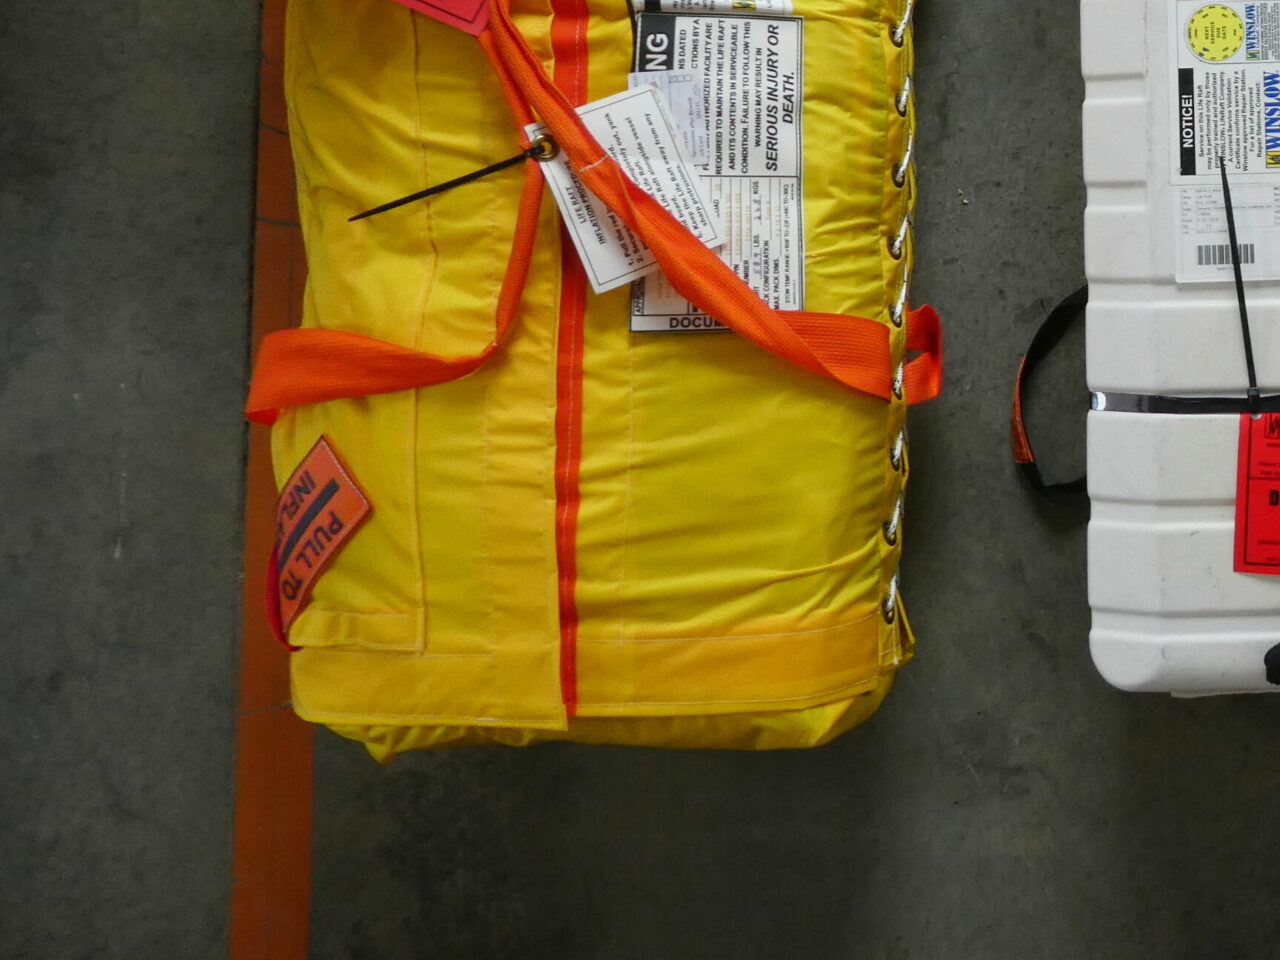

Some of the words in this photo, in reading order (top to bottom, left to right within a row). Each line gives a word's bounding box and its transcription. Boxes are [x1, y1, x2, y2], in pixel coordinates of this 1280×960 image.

[767, 24, 778, 45] OR
[1245, 3, 1255, 50] WINSLOW
[742, 76, 749, 86] TO
[766, 47, 778, 101] INJURY
[782, 71, 794, 123] DEATH.
[643, 111, 654, 127] any
[1263, 70, 1280, 149] WINSLOW
[716, 118, 722, 129] TO
[1181, 94, 1193, 147] NOTICE!
[1199, 124, 1204, 132] on
[648, 127, 661, 145] from
[765, 104, 778, 171] SERIOUS
[657, 144, 671, 165] away
[1205, 147, 1211, 155] be
[665, 164, 677, 182] Raft
[564, 185, 579, 206] RAFT
[673, 182, 684, 197] Life
[680, 197, 690, 210] the
[574, 205, 587, 224] LIFE
[583, 203, 607, 244] INFLATION
[685, 209, 700, 230] Keep
[693, 205, 708, 227] sharp
[296, 510, 344, 569] PULL
[281, 571, 303, 602] TO
